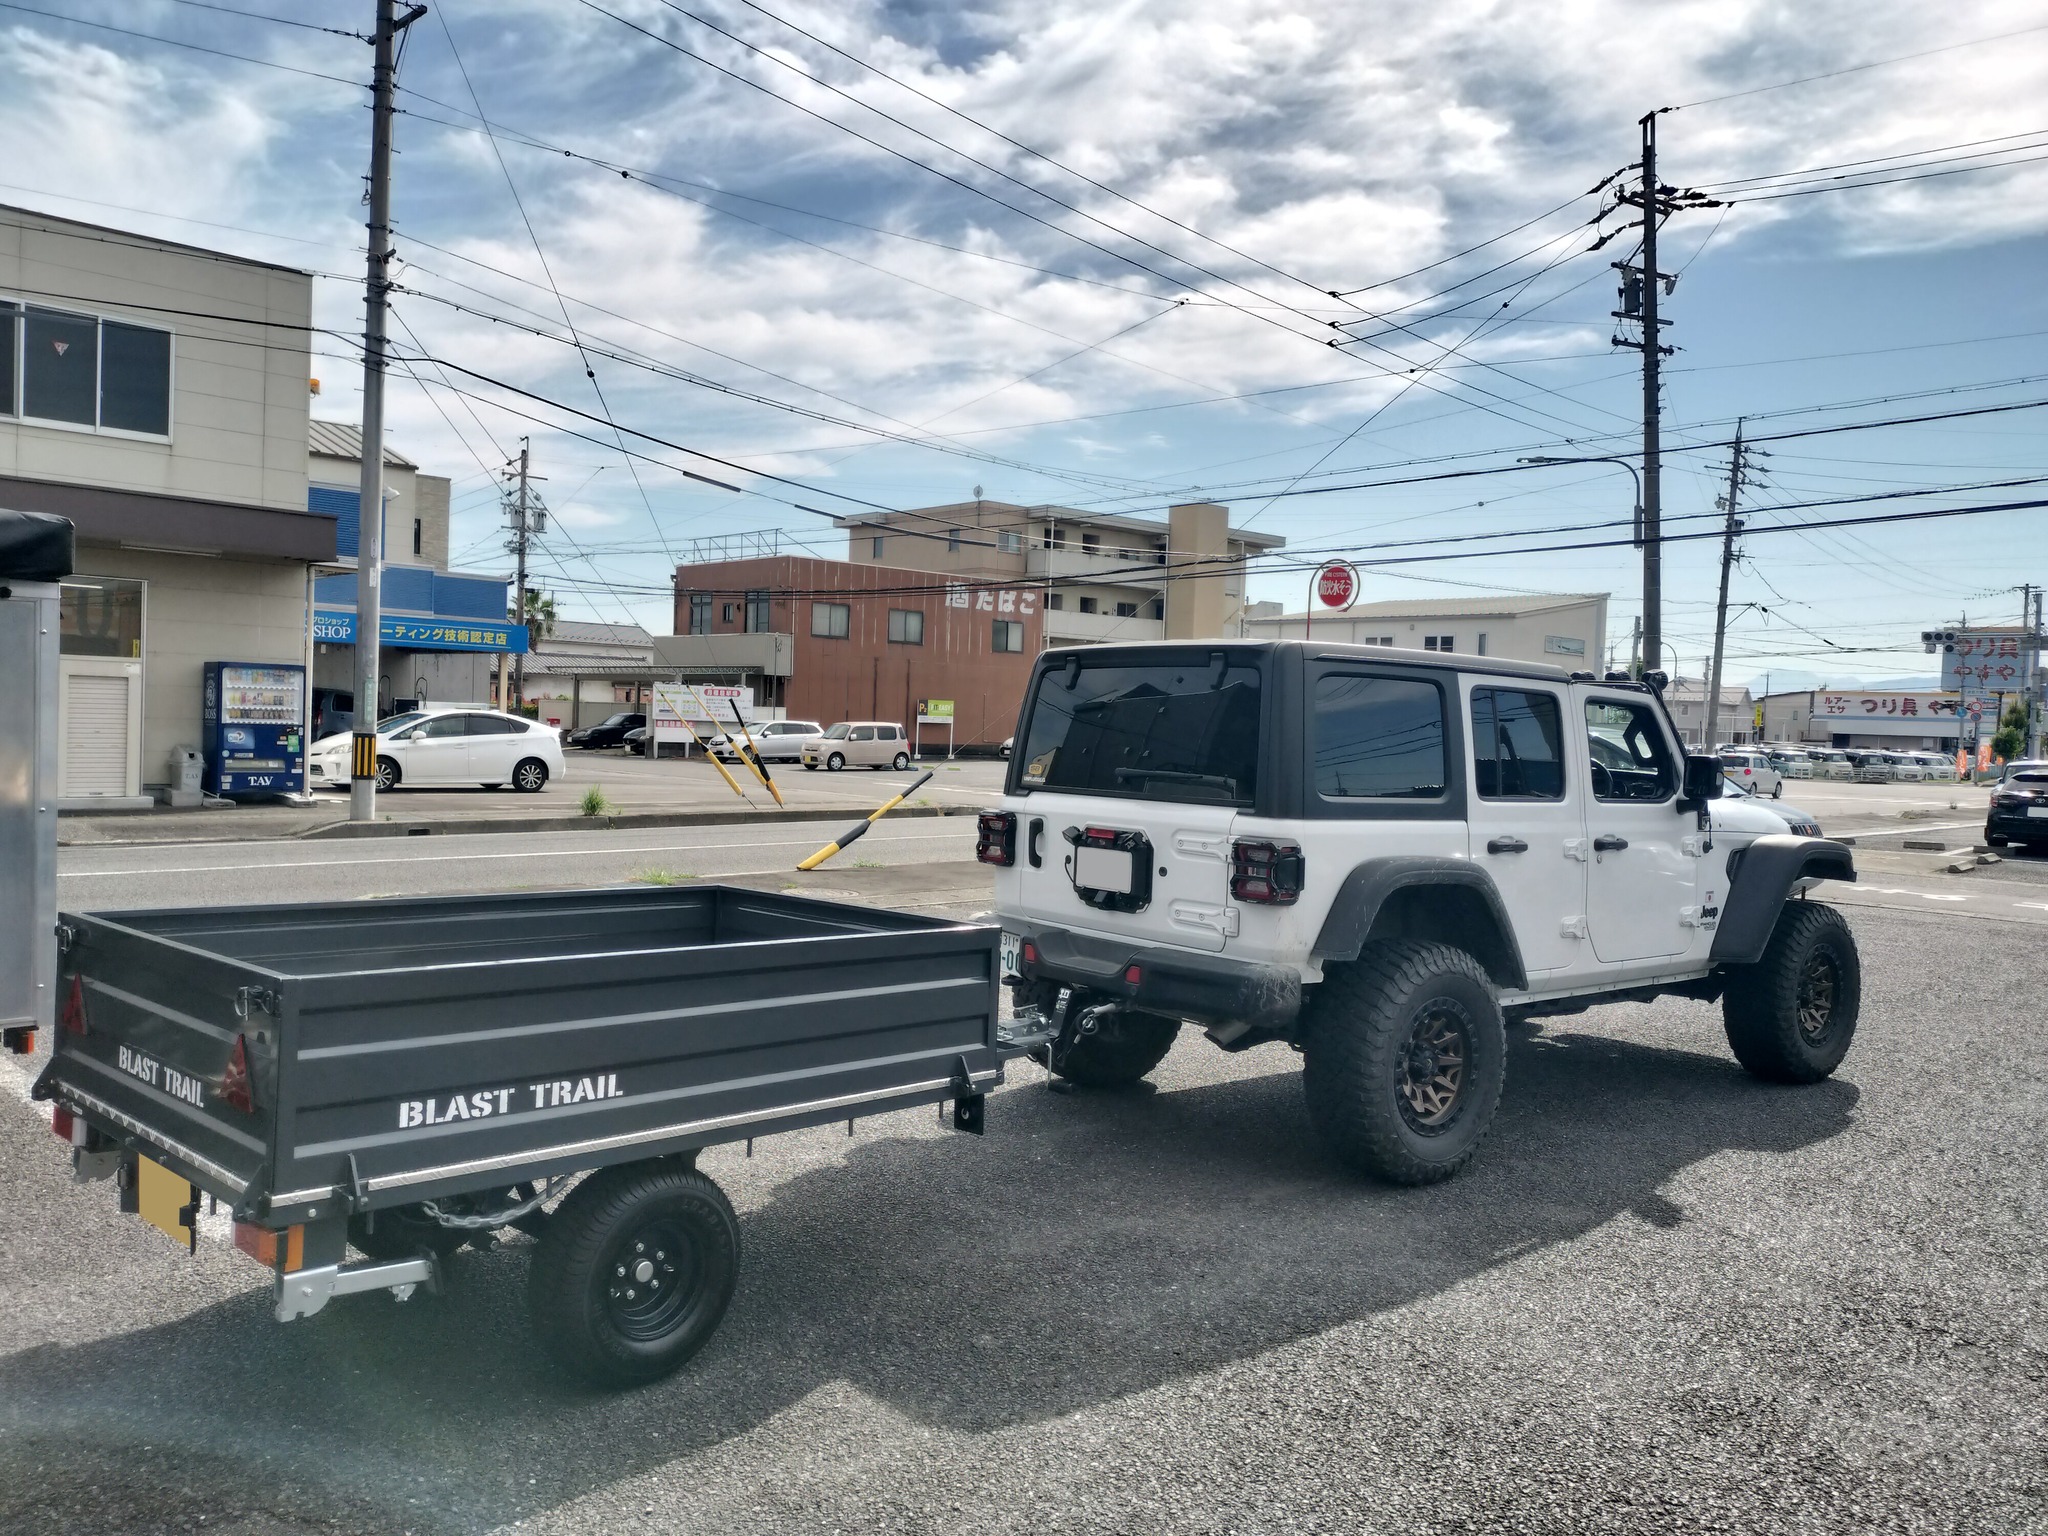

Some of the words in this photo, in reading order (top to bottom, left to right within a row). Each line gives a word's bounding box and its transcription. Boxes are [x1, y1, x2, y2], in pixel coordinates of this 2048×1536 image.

[1700, 904, 1718, 920] Jeep
[118, 1045, 159, 1085] BLAST
[163, 1066, 205, 1108] TRAIL
[398, 1087, 516, 1129] BLAST
[529, 1073, 624, 1109] TRAIL
